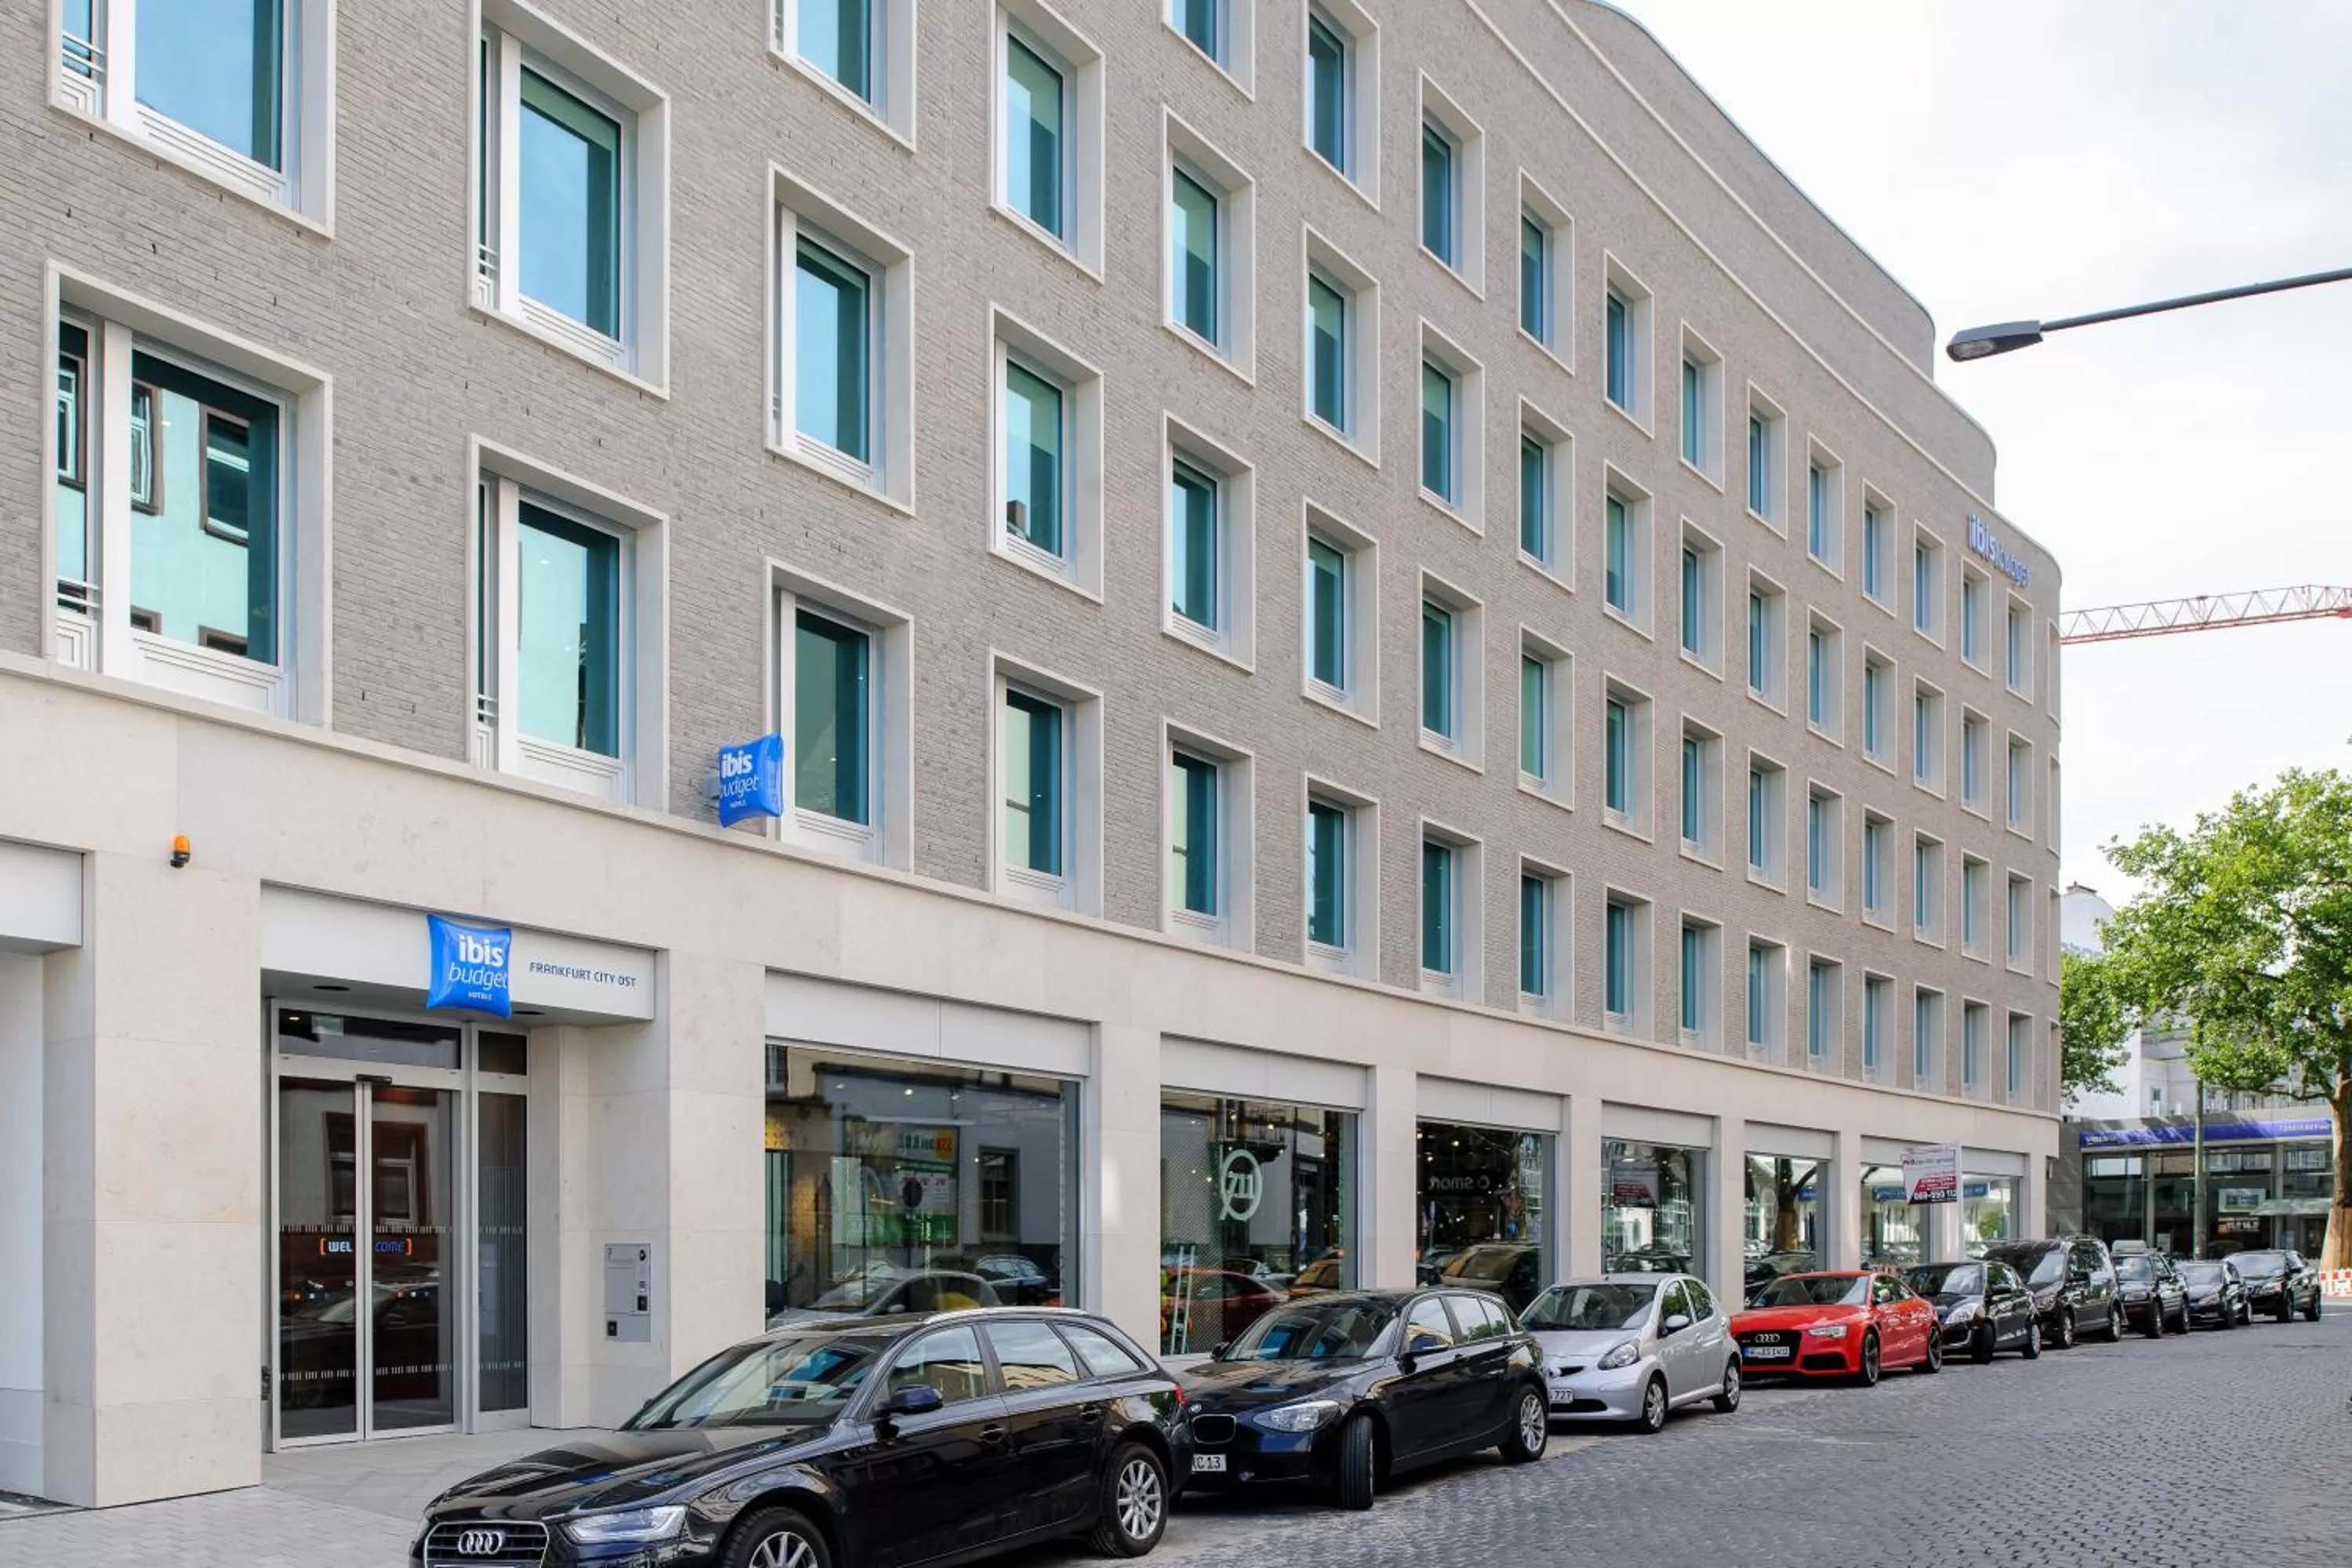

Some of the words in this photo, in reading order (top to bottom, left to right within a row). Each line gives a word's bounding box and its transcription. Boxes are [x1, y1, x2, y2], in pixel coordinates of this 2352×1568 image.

[1968, 514, 1995, 561] ibis
[720, 750, 753, 778] ibis
[458, 934, 504, 967] ibis
[448, 962, 508, 990] budget
[528, 961, 590, 981] FRANKFURT
[593, 971, 615, 985] CITY
[617, 975, 637, 987] OST
[1555, 1390, 1572, 1399] 727
[1207, 1456, 1221, 1469] 13
